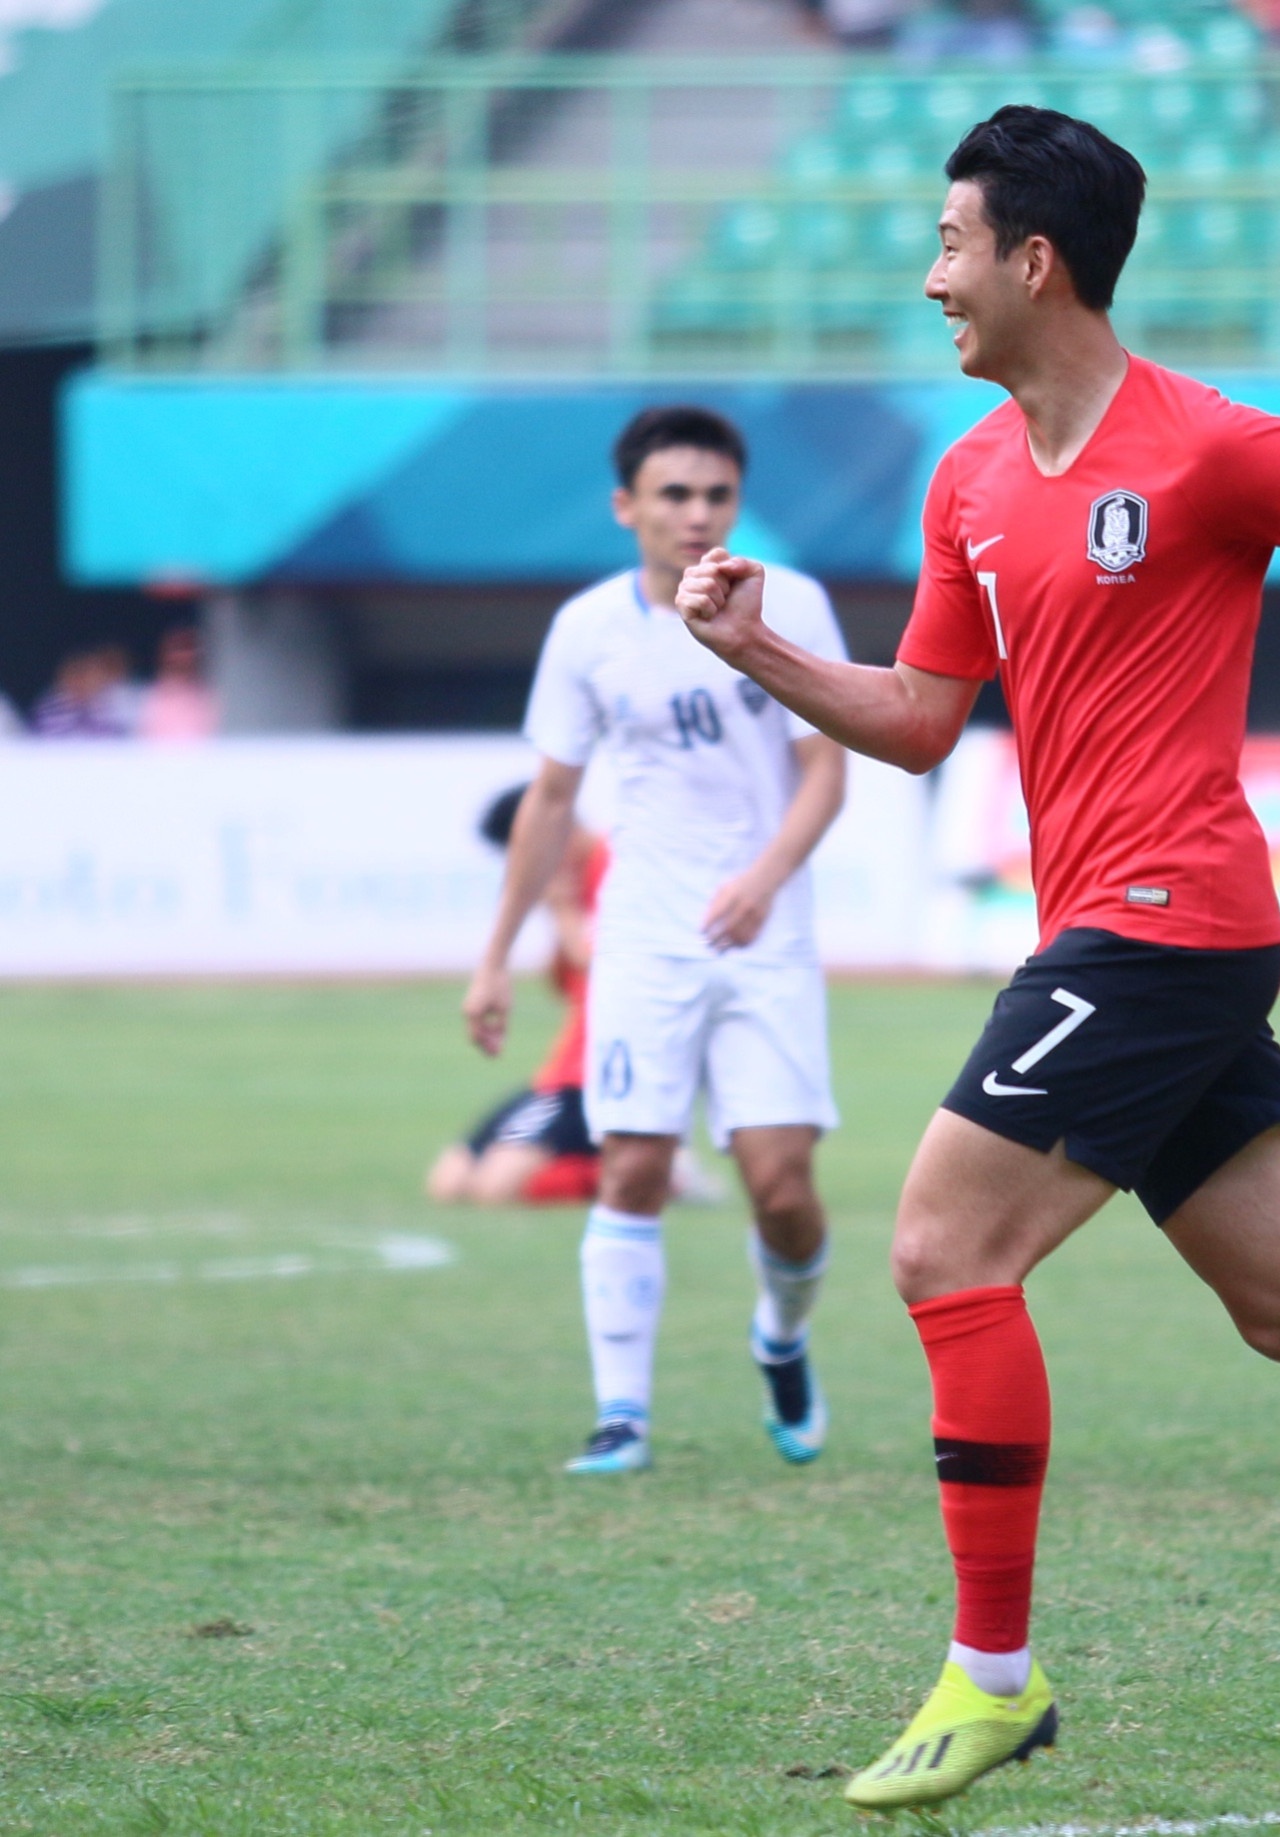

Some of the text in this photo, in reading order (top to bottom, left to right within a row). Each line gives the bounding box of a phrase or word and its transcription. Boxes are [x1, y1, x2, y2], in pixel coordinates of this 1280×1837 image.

[1096, 574, 1136, 585] KOREA
[671, 687, 723, 750] 10
[1010, 987, 1097, 1075] 7
